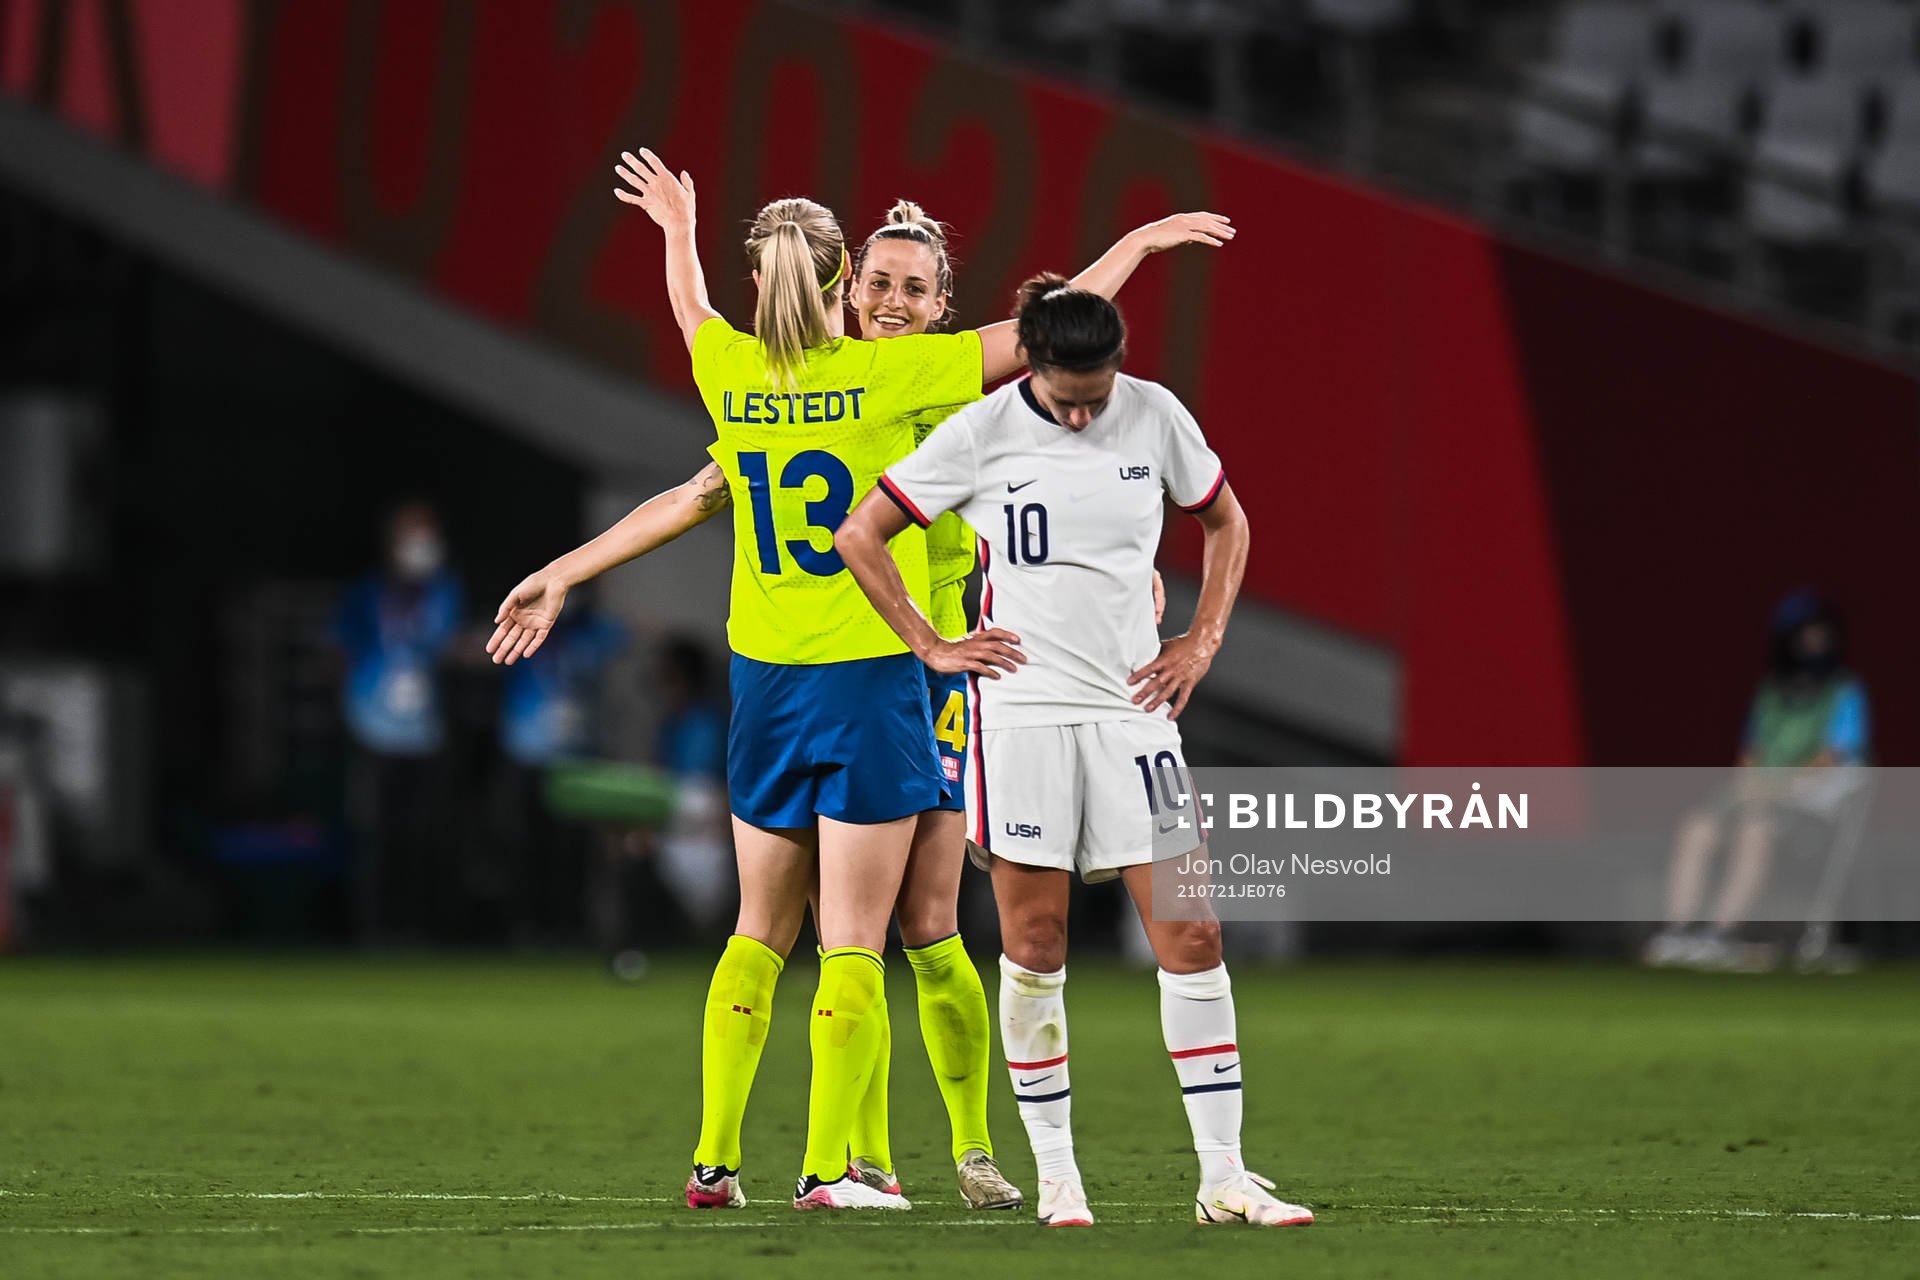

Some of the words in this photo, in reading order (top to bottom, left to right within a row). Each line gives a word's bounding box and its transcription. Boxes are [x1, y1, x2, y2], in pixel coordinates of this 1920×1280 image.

[723, 387, 866, 425] ILESTEDT
[1119, 466, 1150, 481] USA
[737, 449, 855, 577] 13
[1003, 502, 1049, 566] 10
[928, 689, 967, 752] 4
[1134, 749, 1187, 816] 10
[1006, 822, 1042, 840] USA
